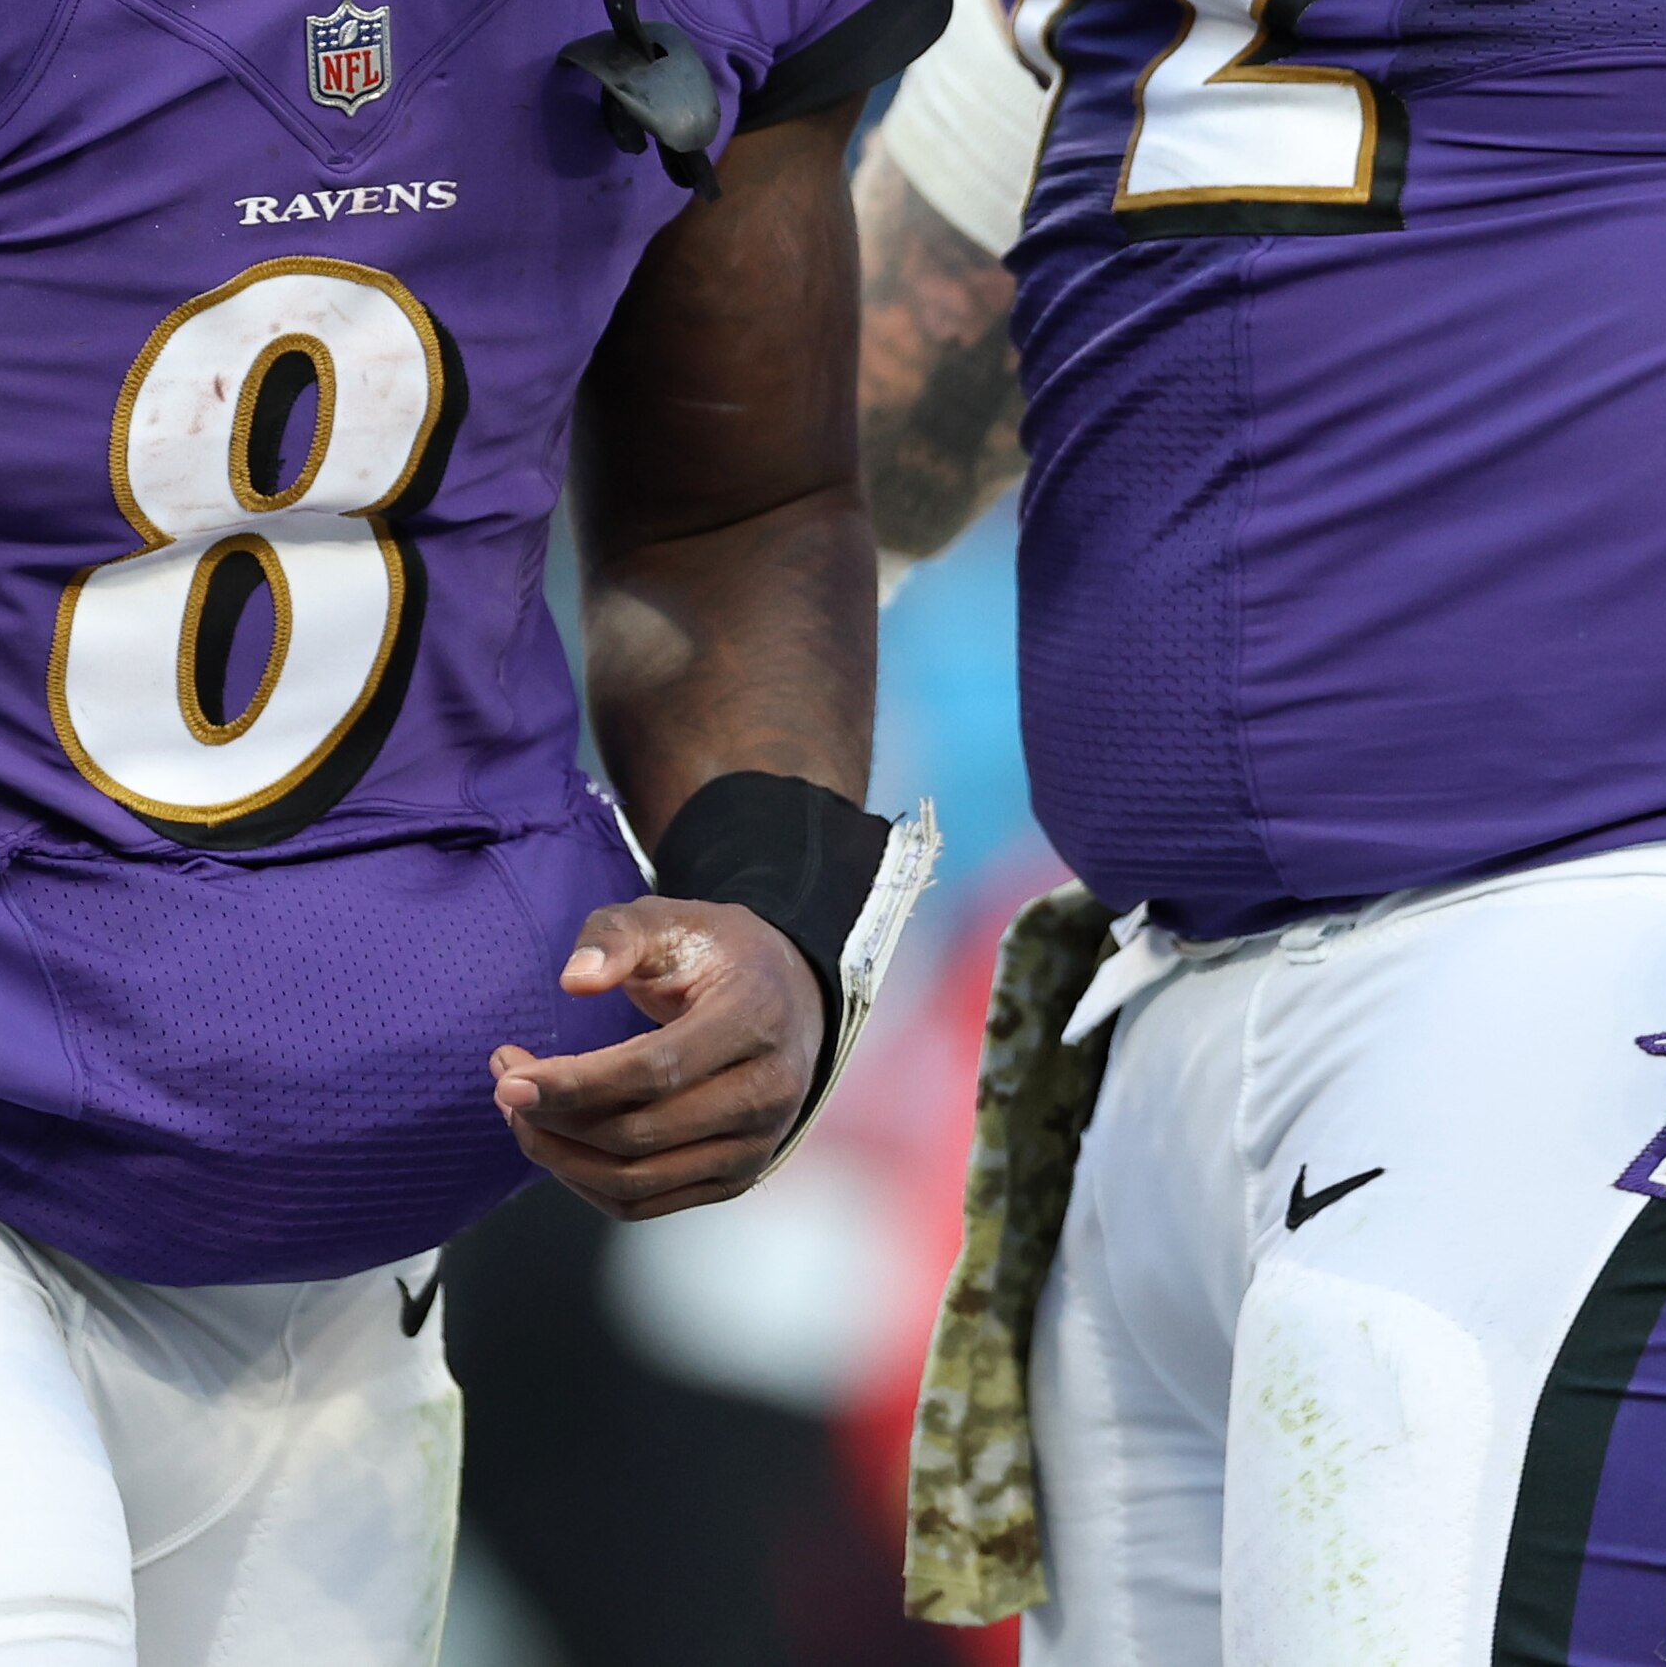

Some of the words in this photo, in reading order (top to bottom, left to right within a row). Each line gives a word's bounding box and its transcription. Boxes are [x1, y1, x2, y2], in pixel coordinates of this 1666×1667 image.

[322, 50, 380, 94] NFL
[234, 180, 459, 227] RAVENS
[46, 254, 471, 850] 8
